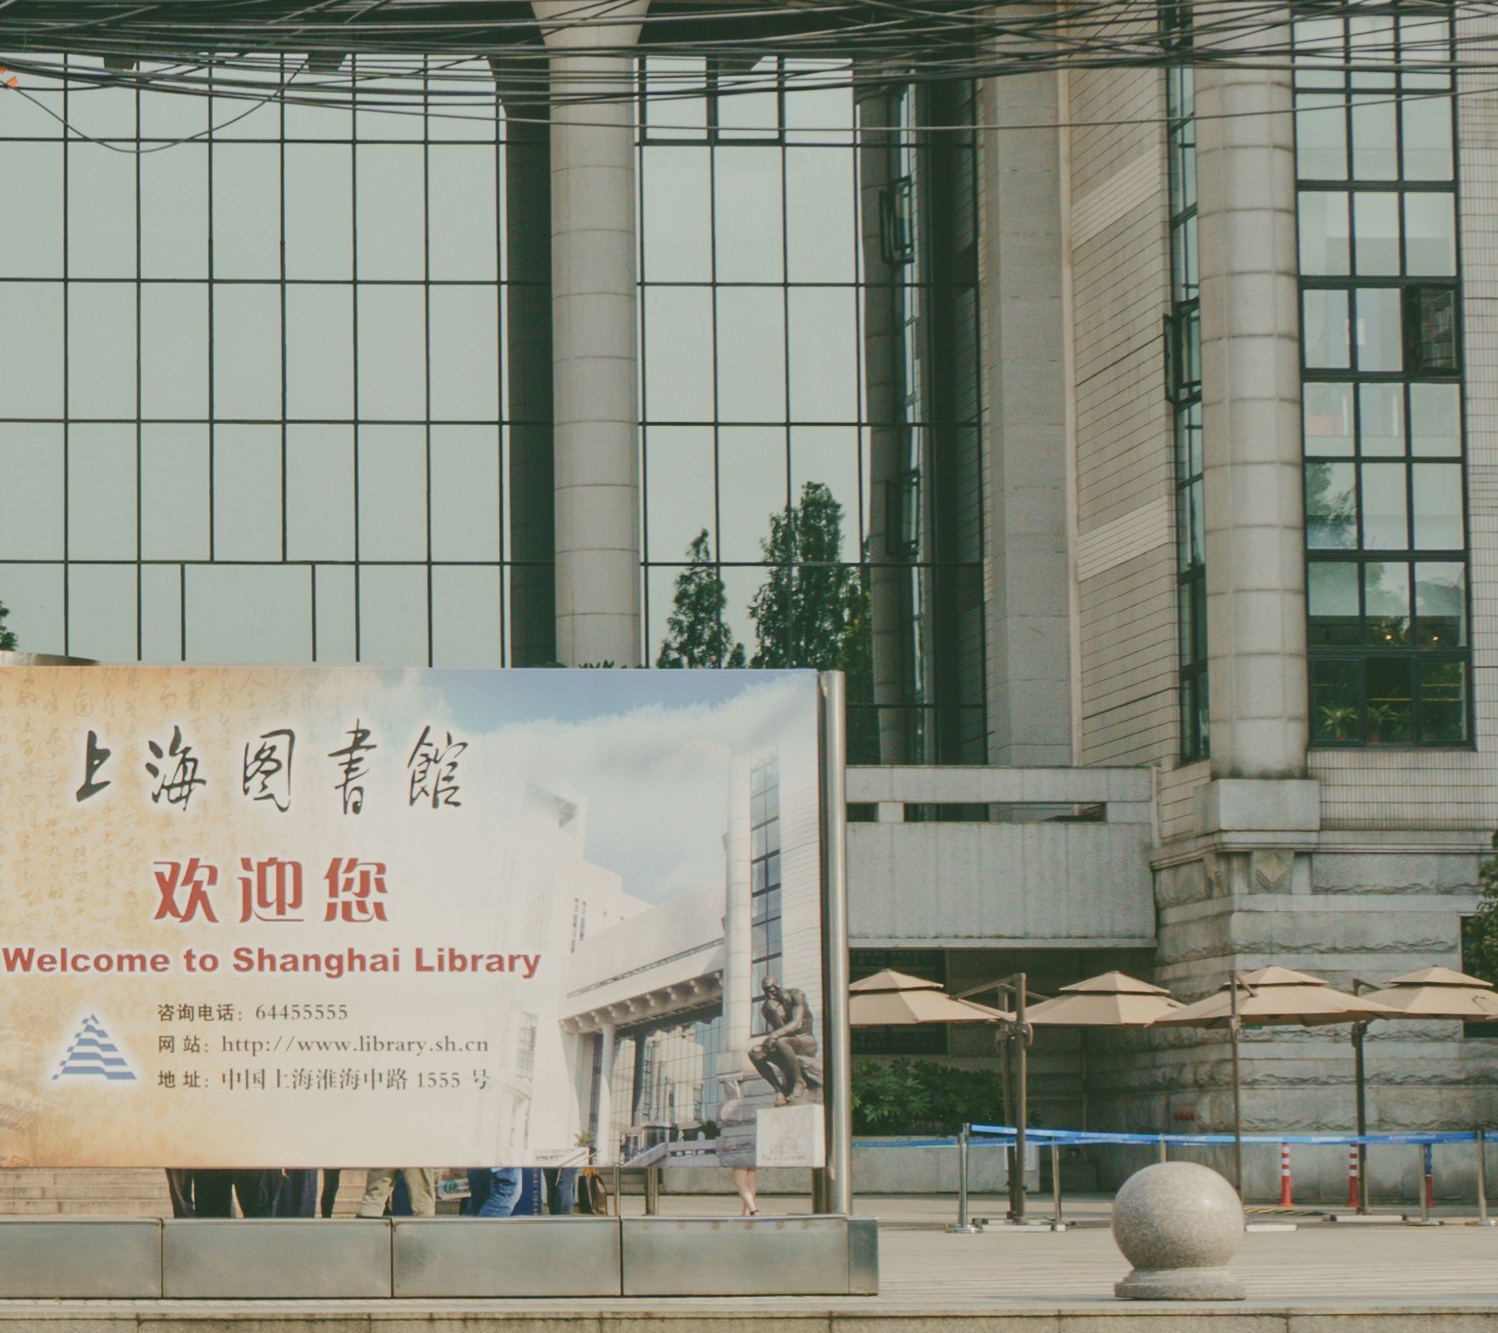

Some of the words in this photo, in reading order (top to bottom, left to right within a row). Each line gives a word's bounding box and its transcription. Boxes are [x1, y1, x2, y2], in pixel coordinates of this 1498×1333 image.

[153, 856, 389, 923] 欢迎您
[2, 947, 170, 972] Welcome
[184, 948, 219, 972] to
[232, 947, 400, 979] Shanghai
[414, 947, 541, 979] Library
[254, 1003, 349, 1021] 64455555
[221, 1034, 490, 1057] http://www.library.sh.cn
